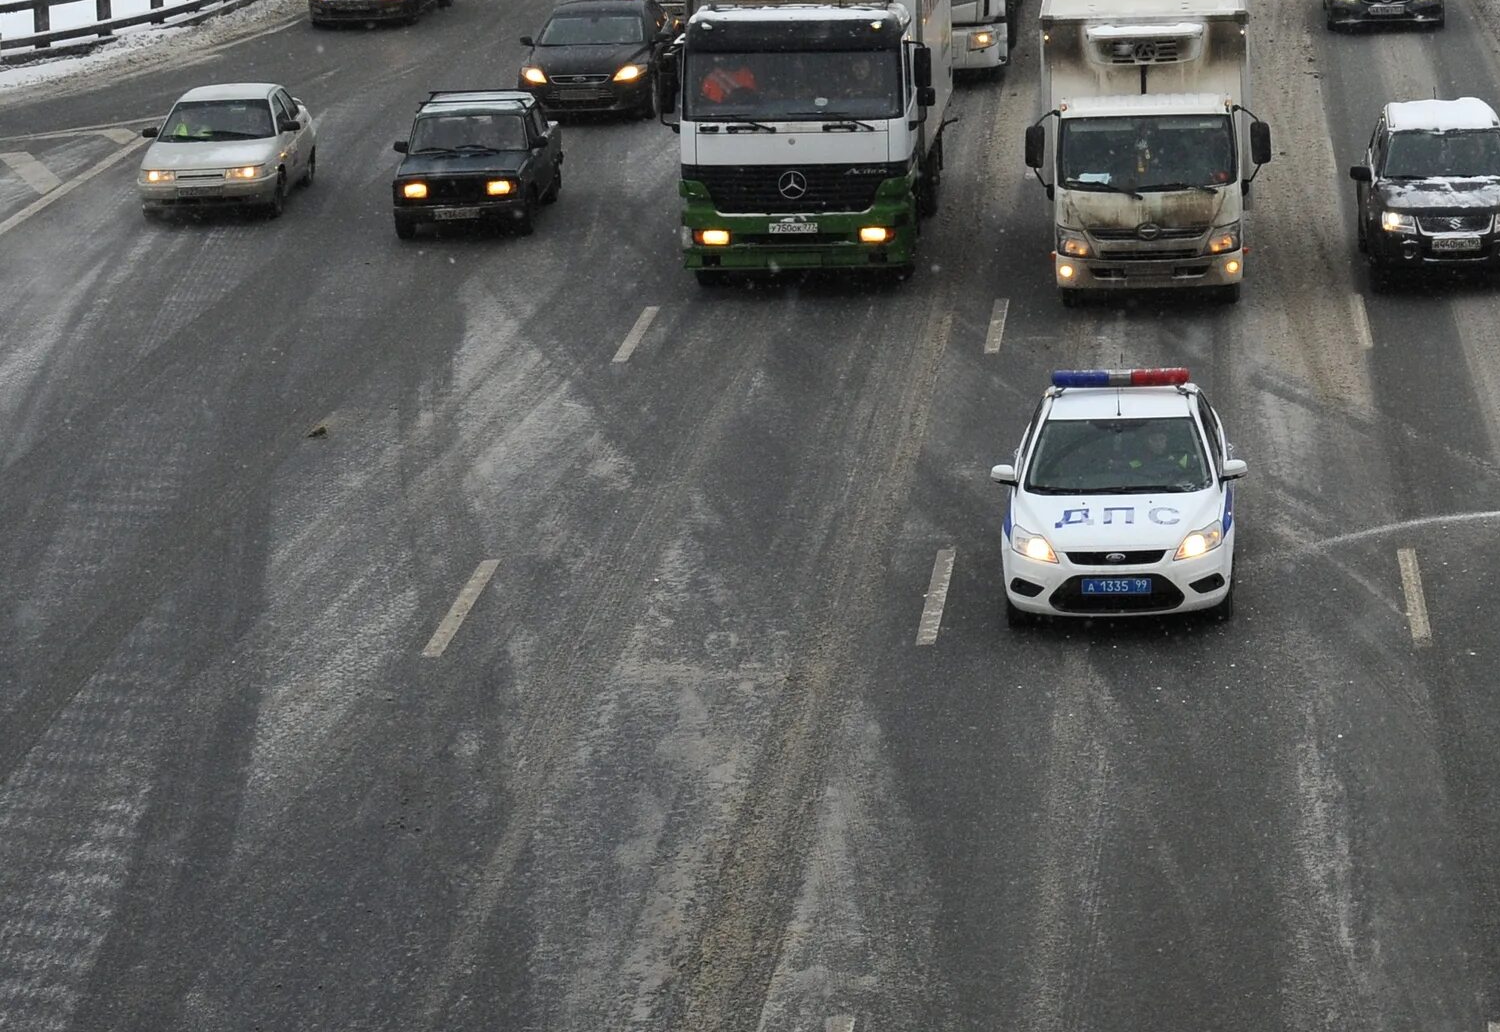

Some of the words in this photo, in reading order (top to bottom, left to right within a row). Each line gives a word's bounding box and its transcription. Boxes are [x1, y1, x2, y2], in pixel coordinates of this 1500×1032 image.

[1054, 507, 1181, 529] ДПС
[1087, 583, 1095, 592] А
[1100, 580, 1129, 592] 1335
[1135, 579, 1147, 589] 99
